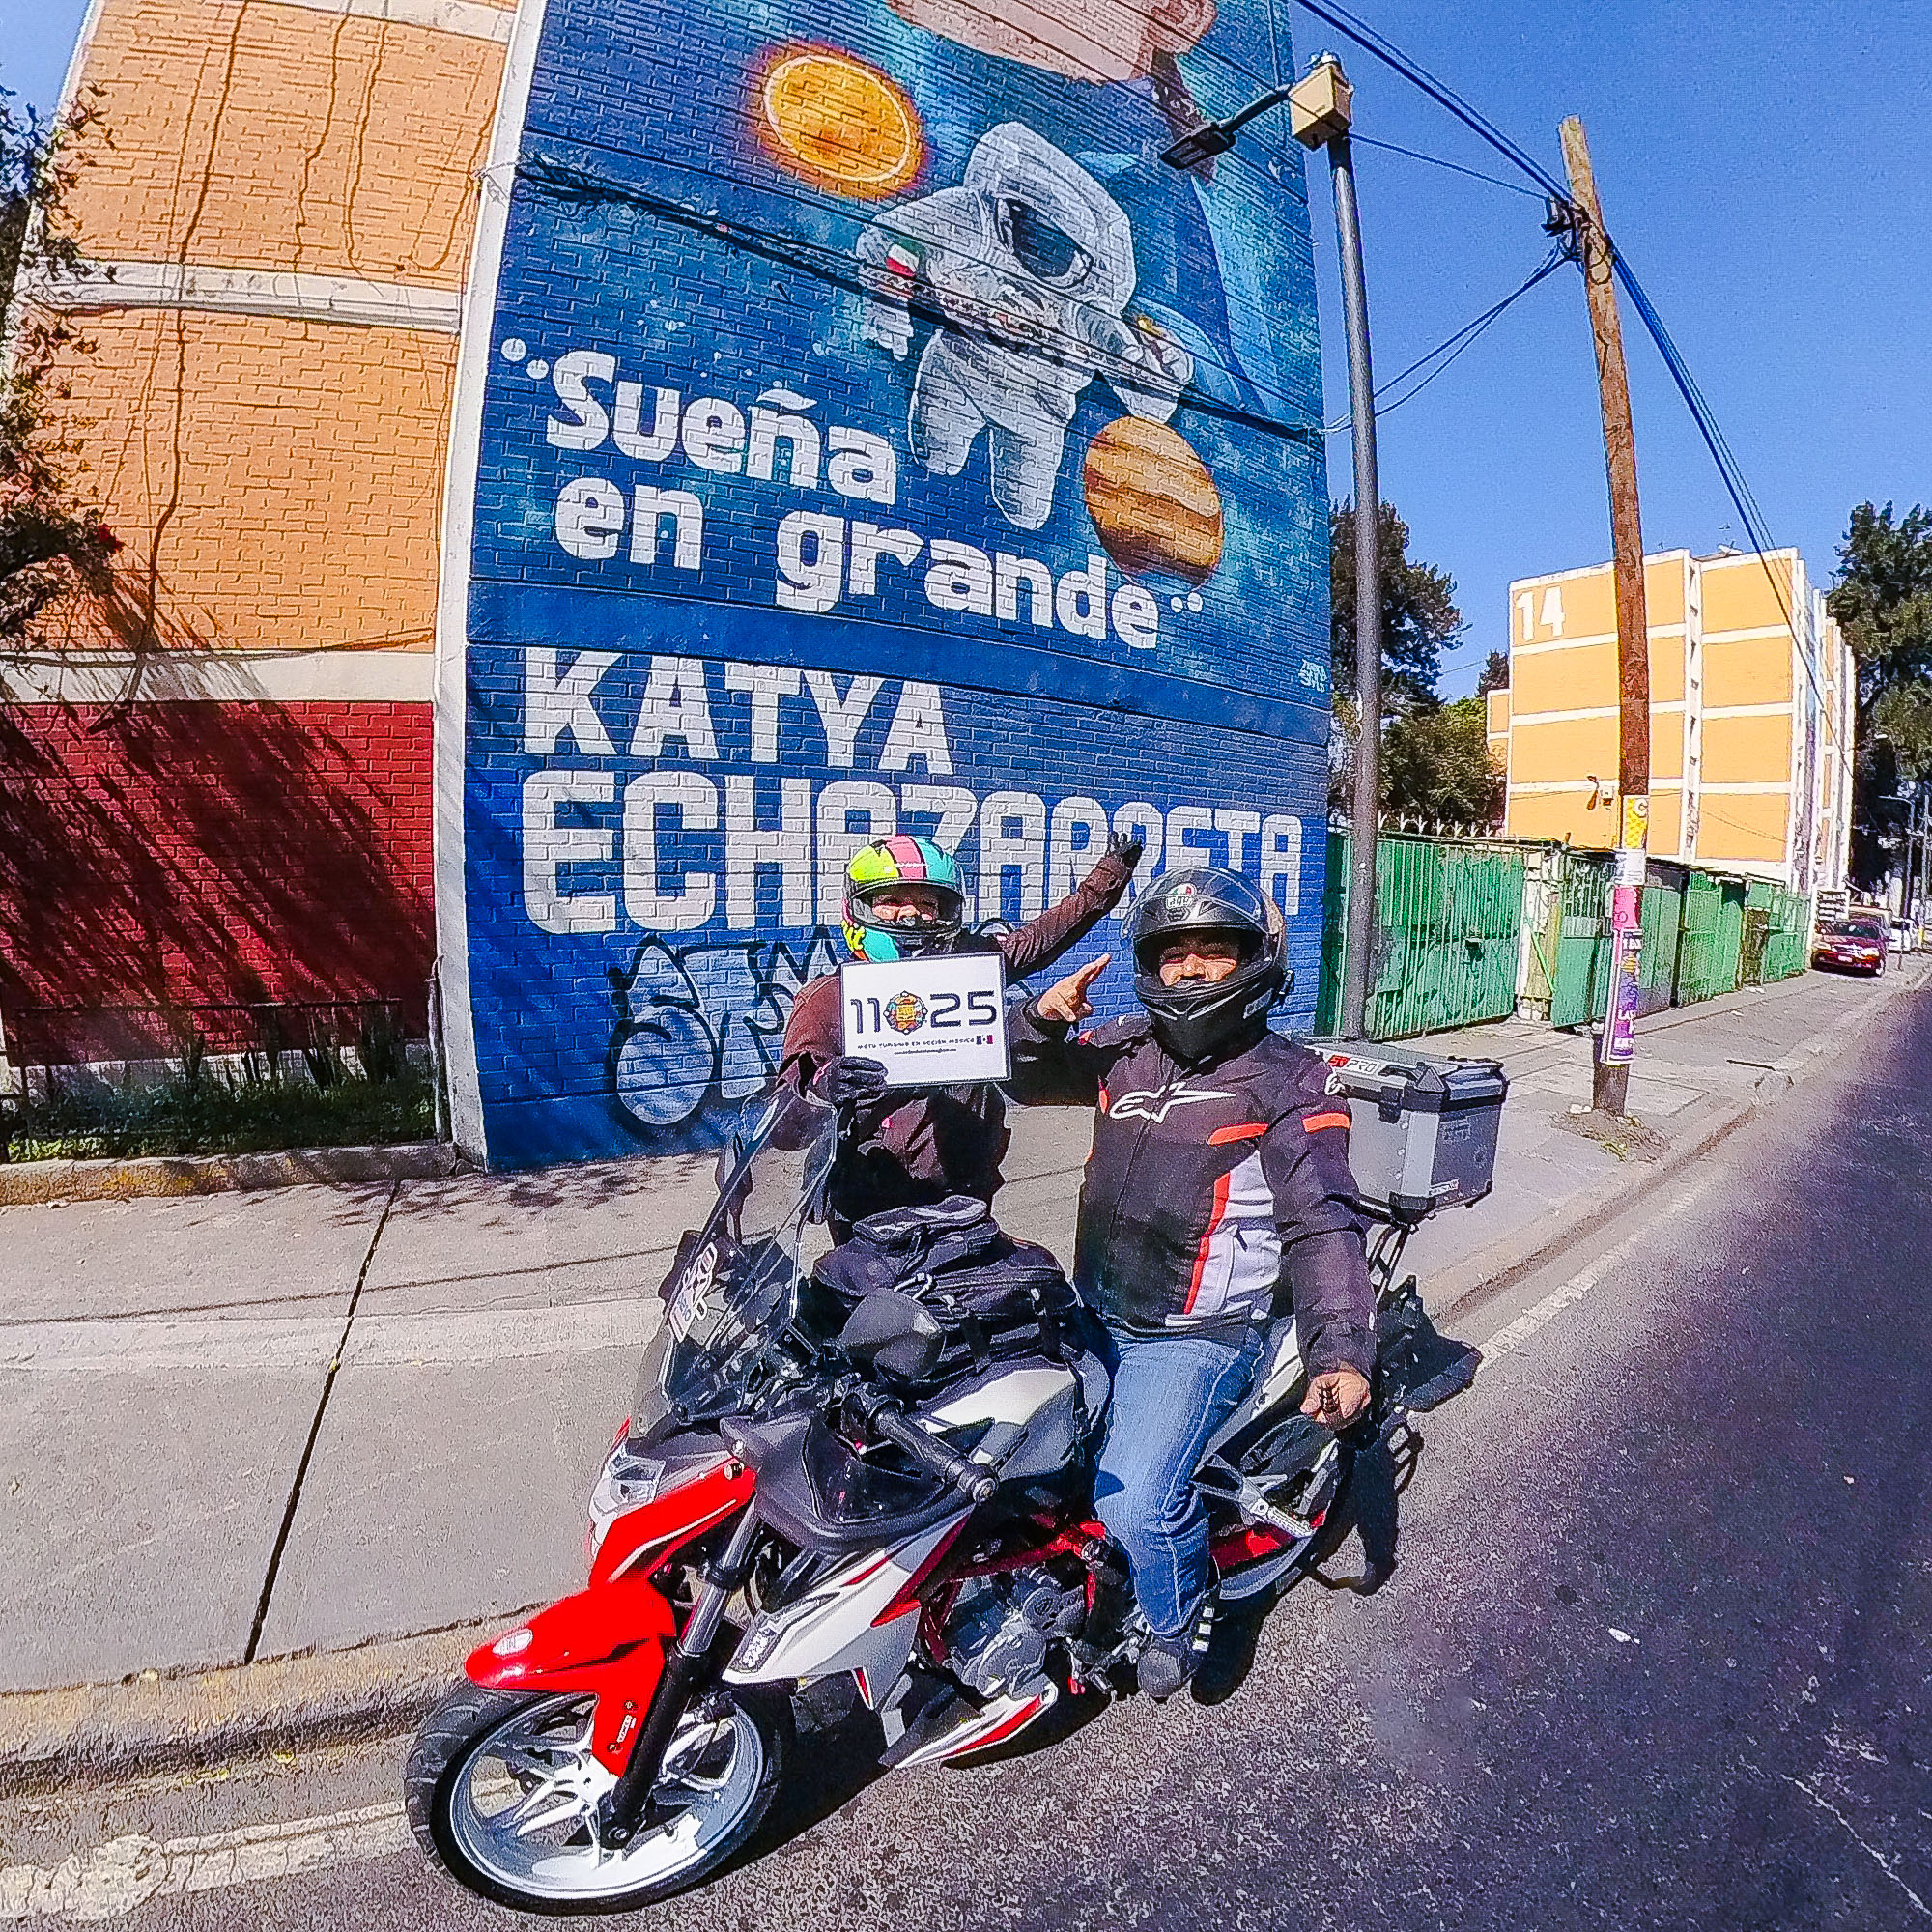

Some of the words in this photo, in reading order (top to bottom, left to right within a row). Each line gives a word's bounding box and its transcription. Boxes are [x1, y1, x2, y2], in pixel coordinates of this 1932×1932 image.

[554, 477, 704, 572] en
[1515, 586, 1566, 641] 14
[525, 646, 954, 776] KATYA
